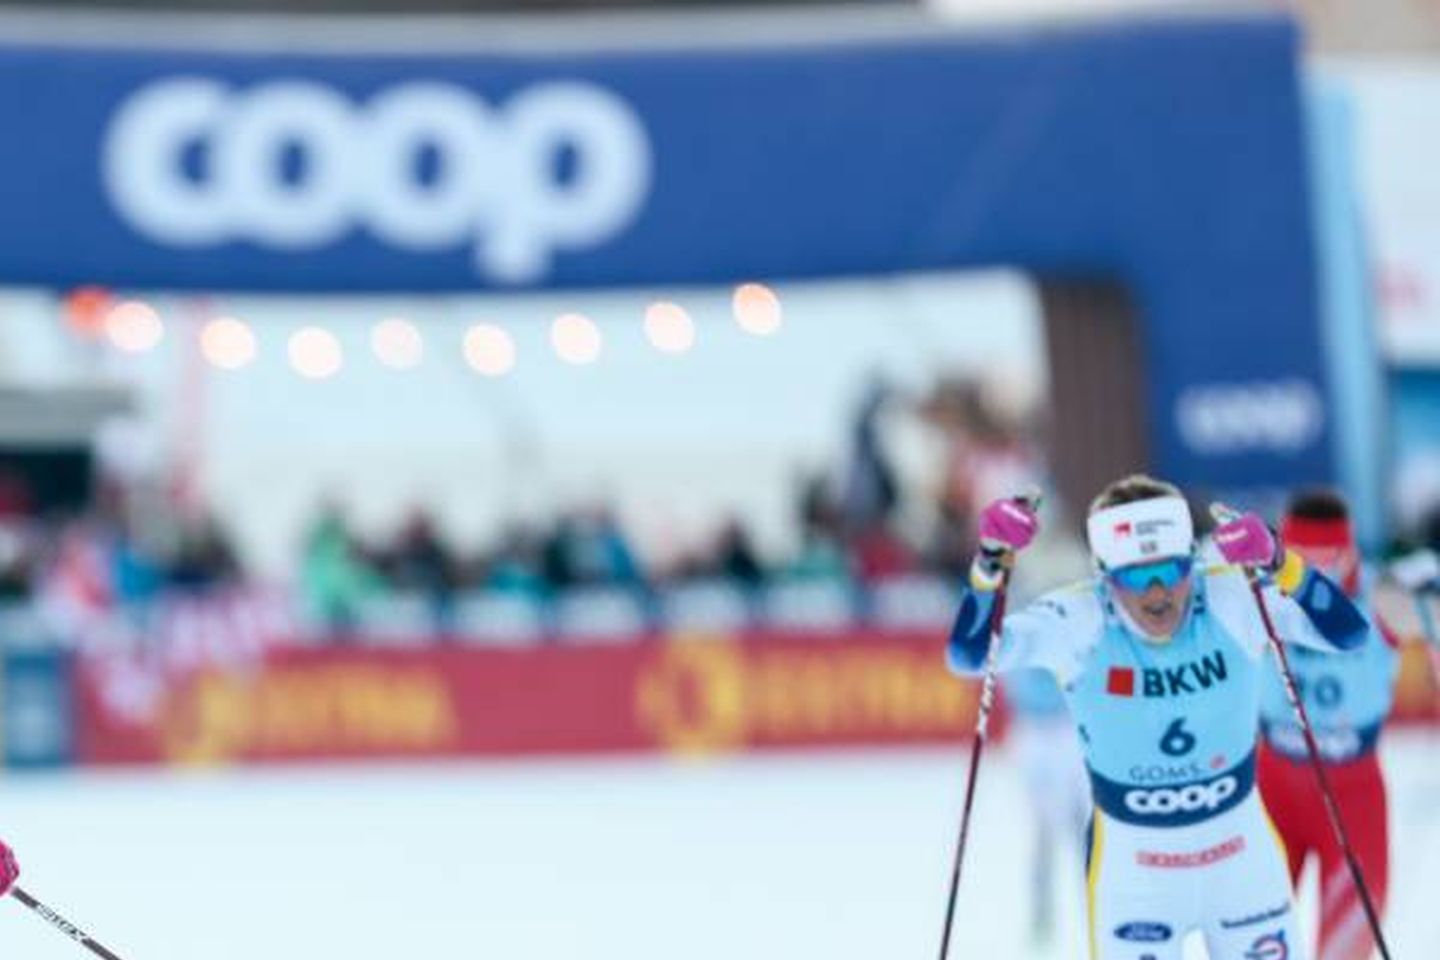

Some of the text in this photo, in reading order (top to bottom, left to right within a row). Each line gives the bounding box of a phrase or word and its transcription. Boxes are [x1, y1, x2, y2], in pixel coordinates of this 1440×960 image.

[101, 75, 653, 282] coop
[1143, 650, 1227, 696] BKW
[1159, 717, 1195, 757] 6
[1124, 775, 1237, 815] coop
